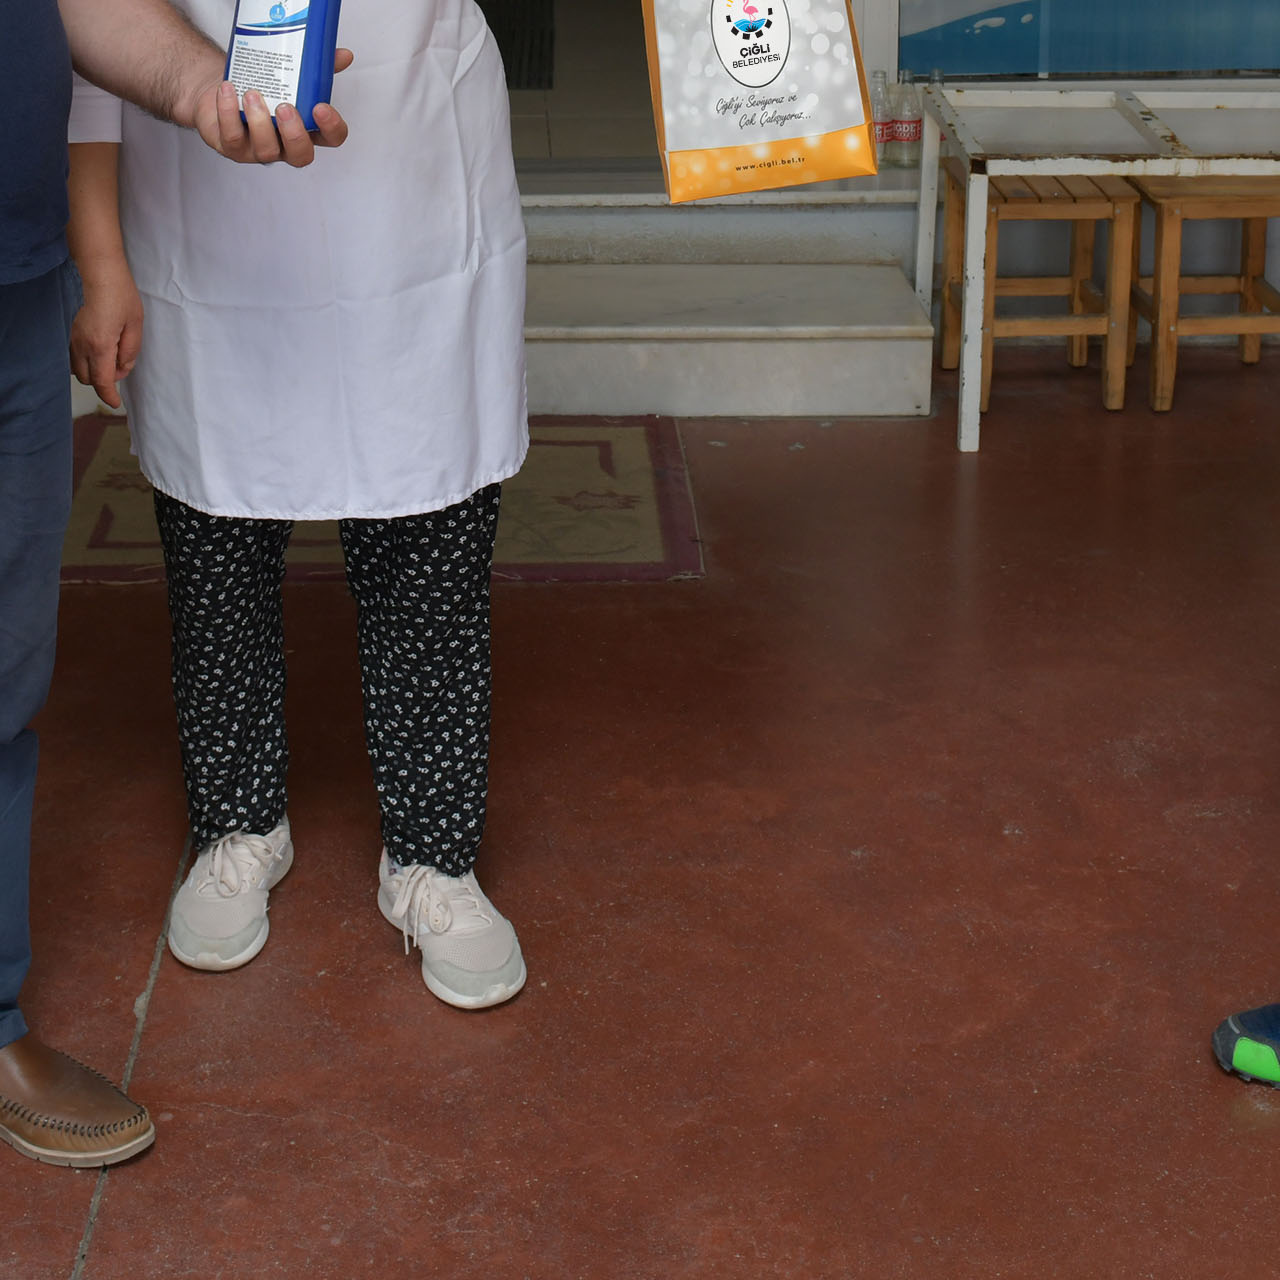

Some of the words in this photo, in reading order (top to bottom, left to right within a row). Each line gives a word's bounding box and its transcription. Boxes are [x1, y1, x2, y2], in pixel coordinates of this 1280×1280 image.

[788, 94, 798, 102] ve
[739, 113, 756, 129] Çok
[735, 157, 806, 171] www.cigli.bel.tr
